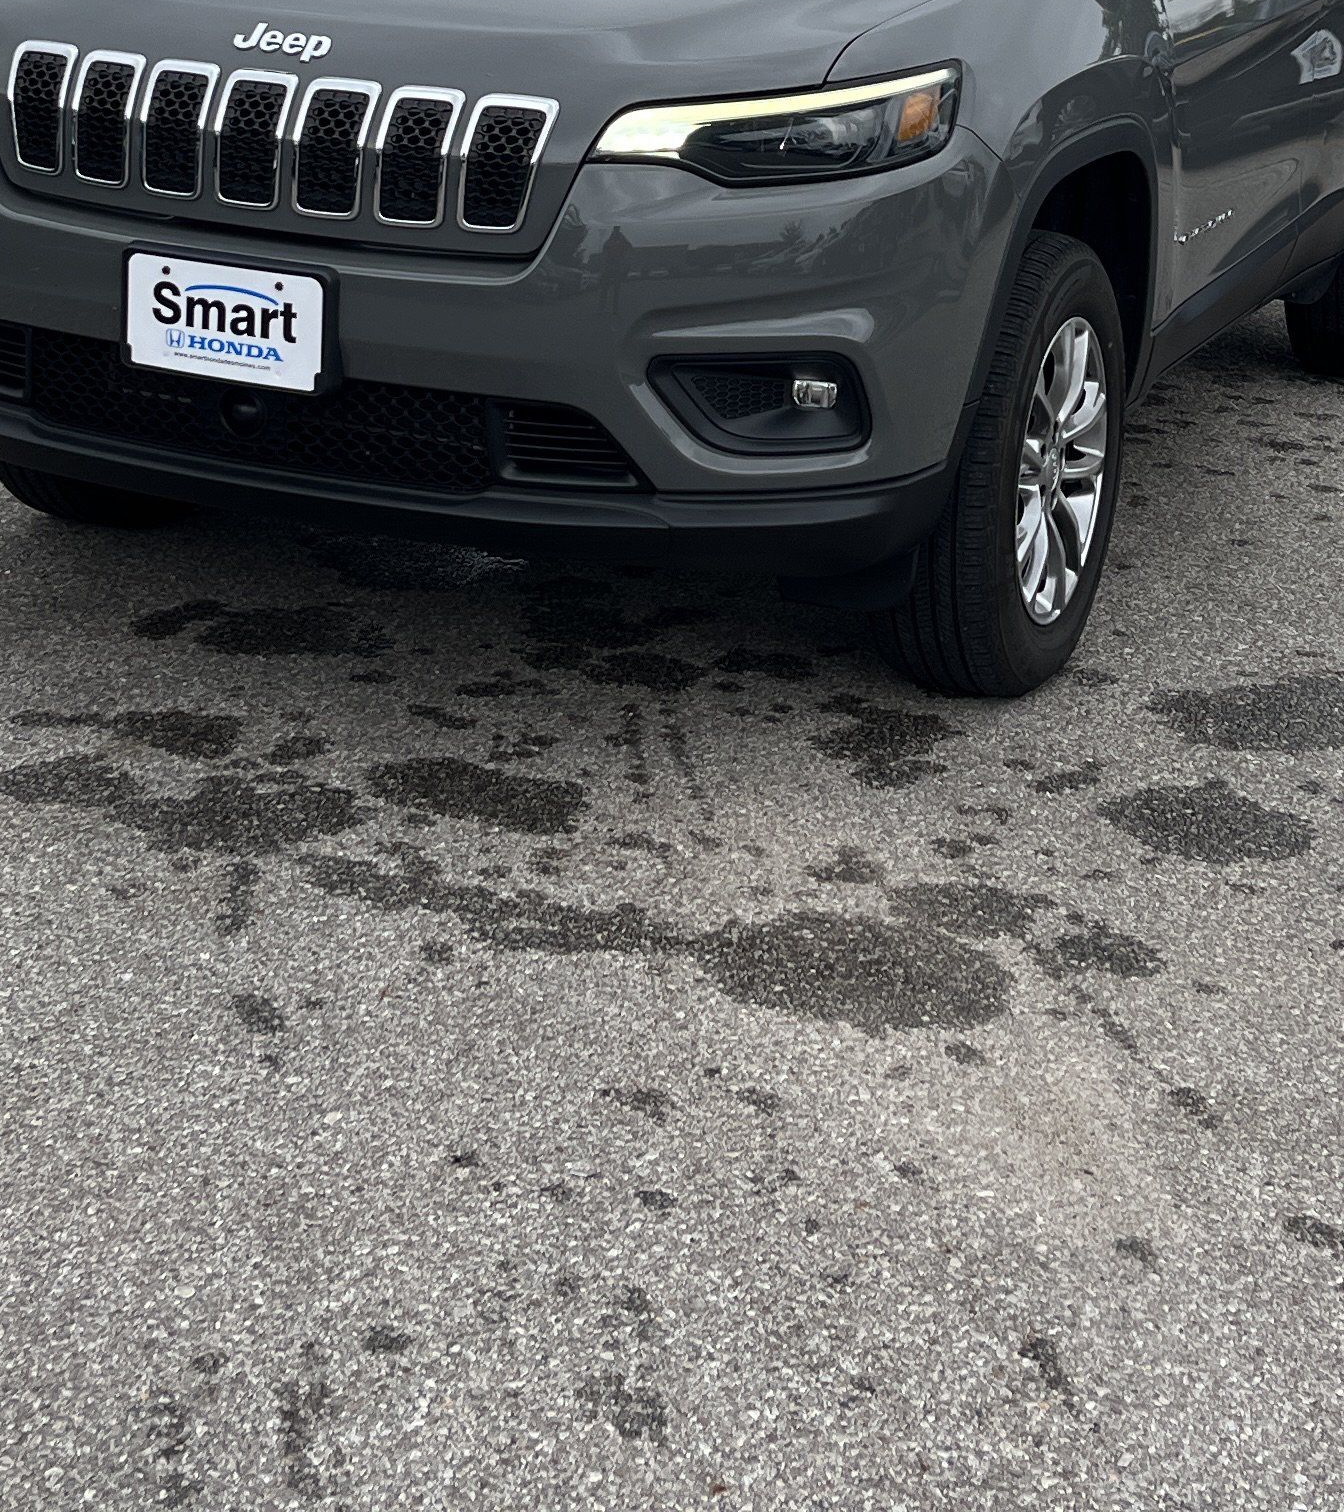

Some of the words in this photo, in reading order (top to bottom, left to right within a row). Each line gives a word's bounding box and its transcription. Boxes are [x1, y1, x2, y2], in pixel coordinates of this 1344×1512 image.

[233, 22, 332, 63] Jeep
[152, 281, 298, 344] Smart
[187, 334, 285, 363] HONDA
